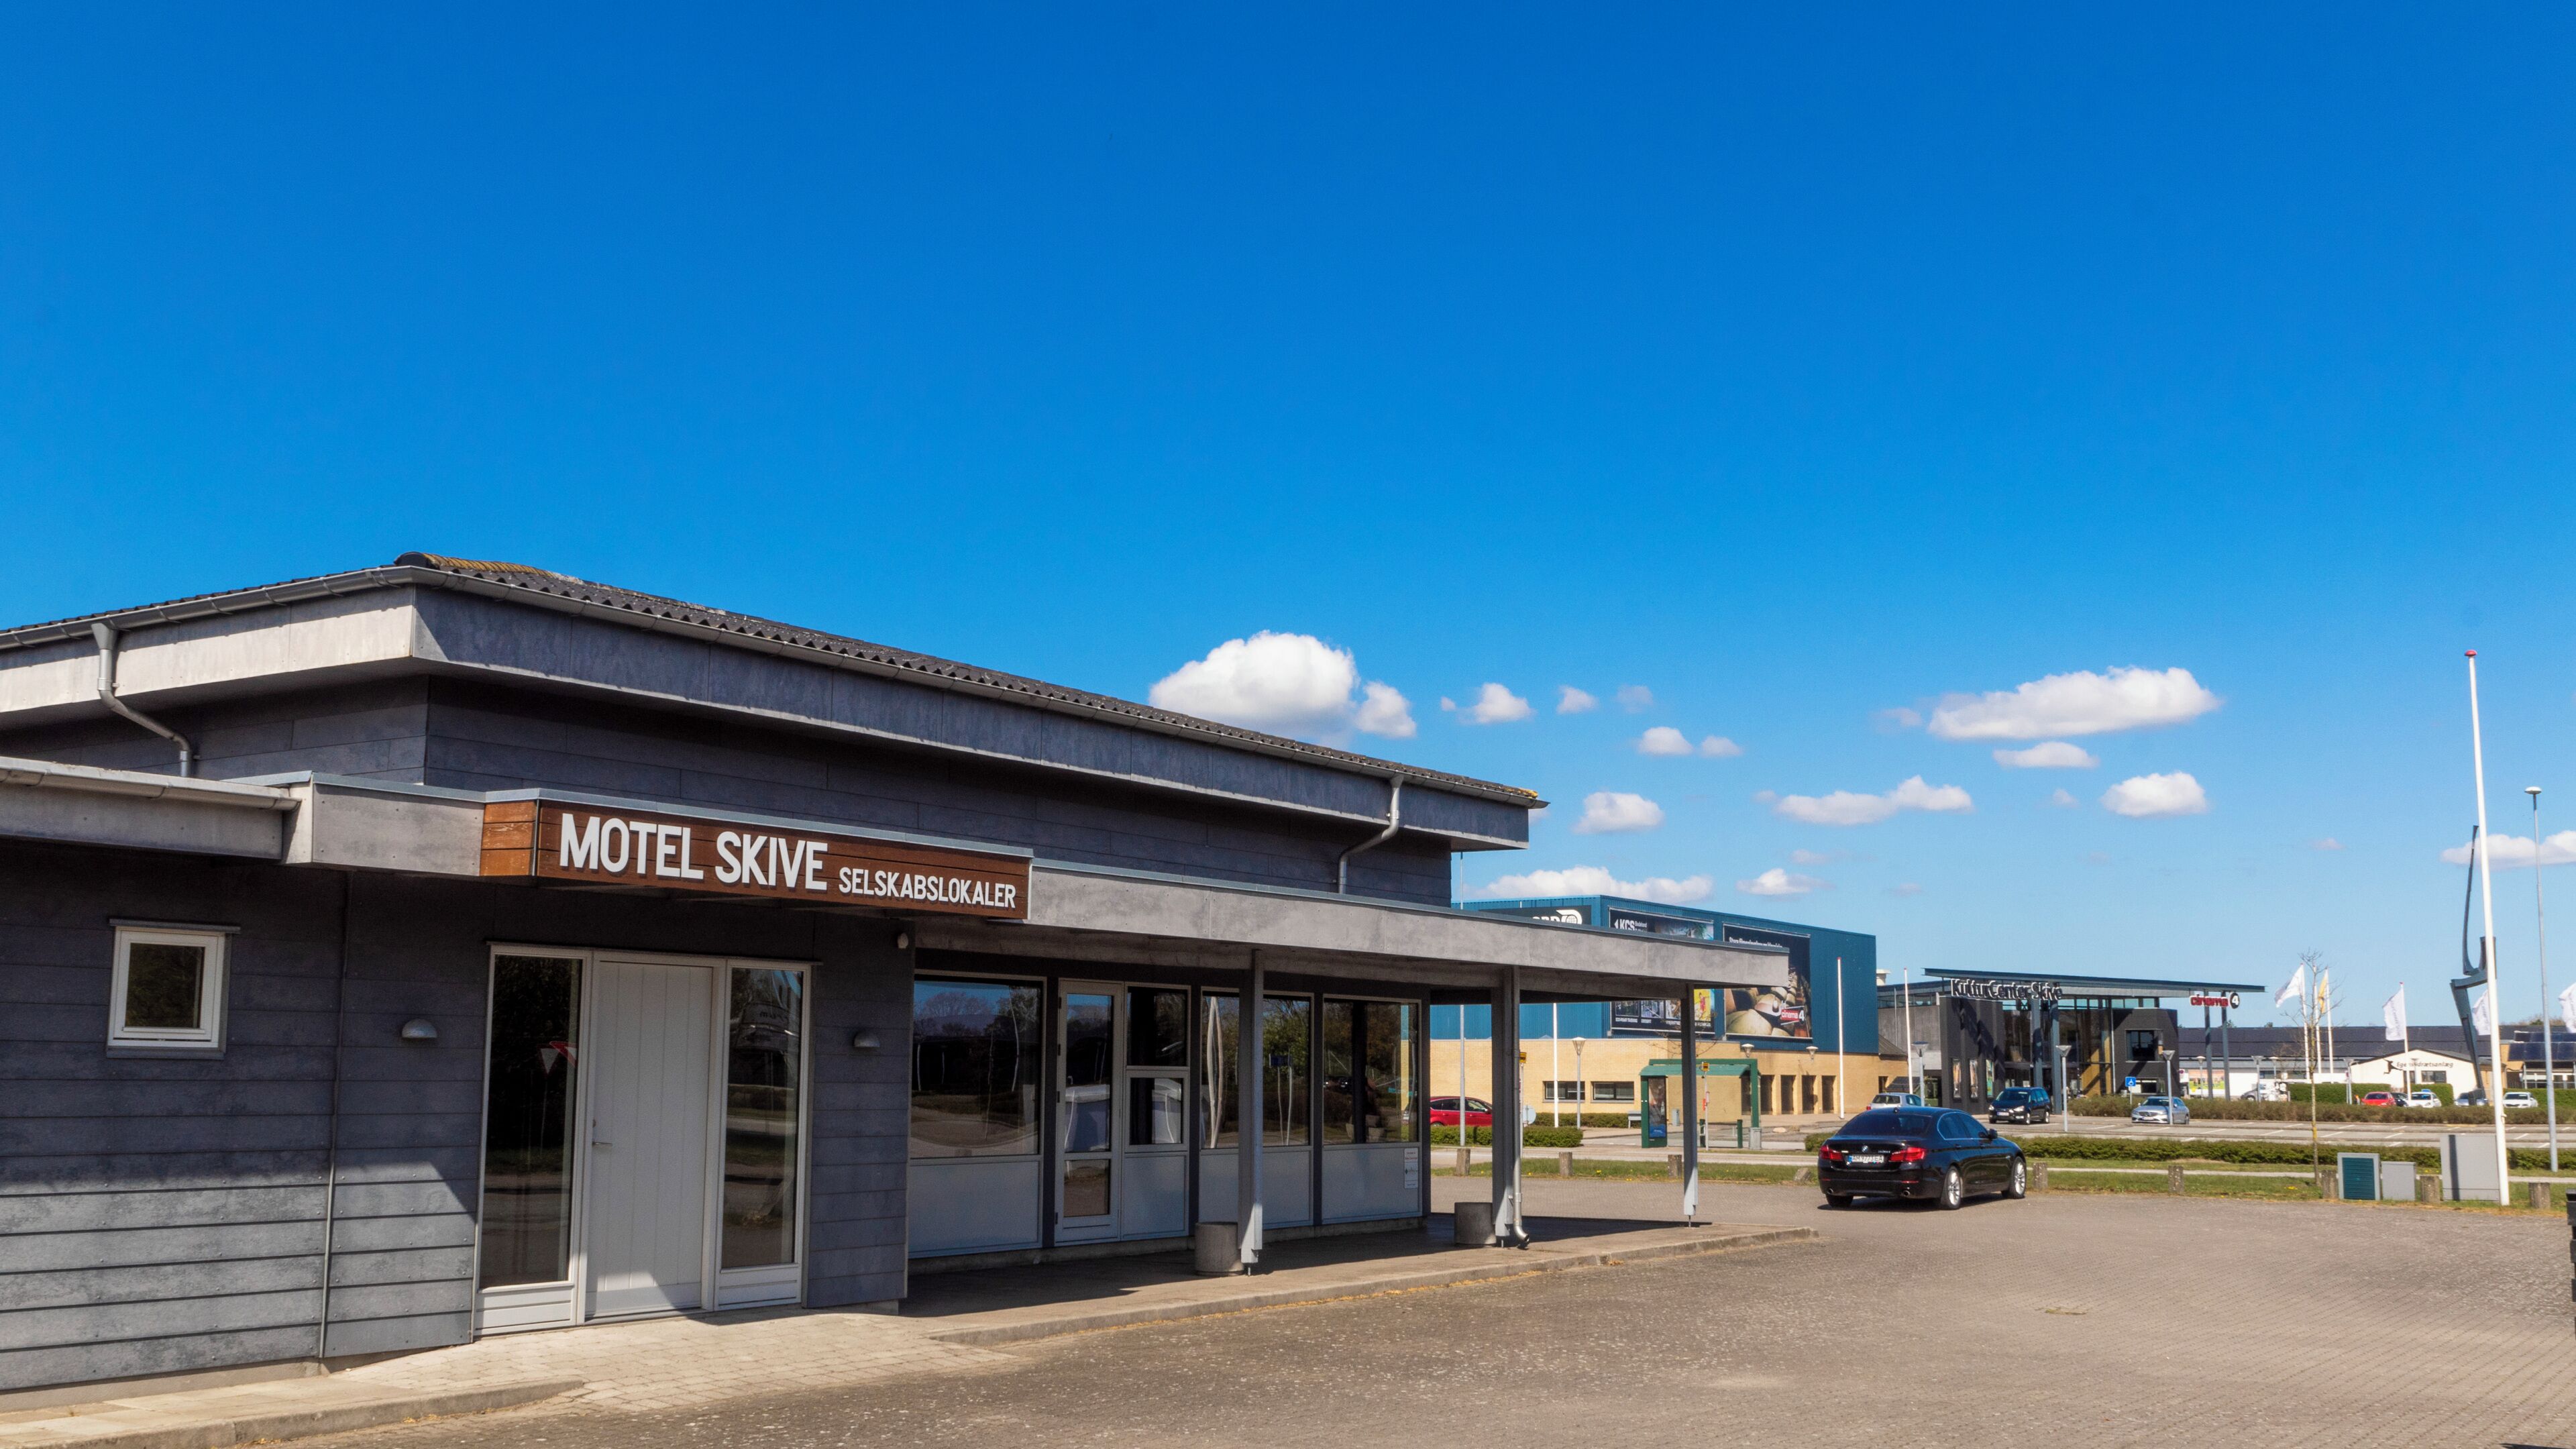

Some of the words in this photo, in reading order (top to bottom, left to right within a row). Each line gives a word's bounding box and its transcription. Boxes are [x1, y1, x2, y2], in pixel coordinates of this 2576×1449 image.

[559, 812, 704, 879] MOTEL
[714, 830, 828, 890] SKIVE
[839, 867, 1016, 909] SELSKABSLOKALER
[1619, 918, 1635, 930] KCS
[1950, 978, 2030, 1000] KulturCenter
[2031, 981, 2063, 1000] Skive
[2190, 994, 2229, 1007] cinema
[2231, 994, 2239, 1006] 4
[1782, 1010, 1799, 1019] cinema
[1799, 1010, 1805, 1021] 4
